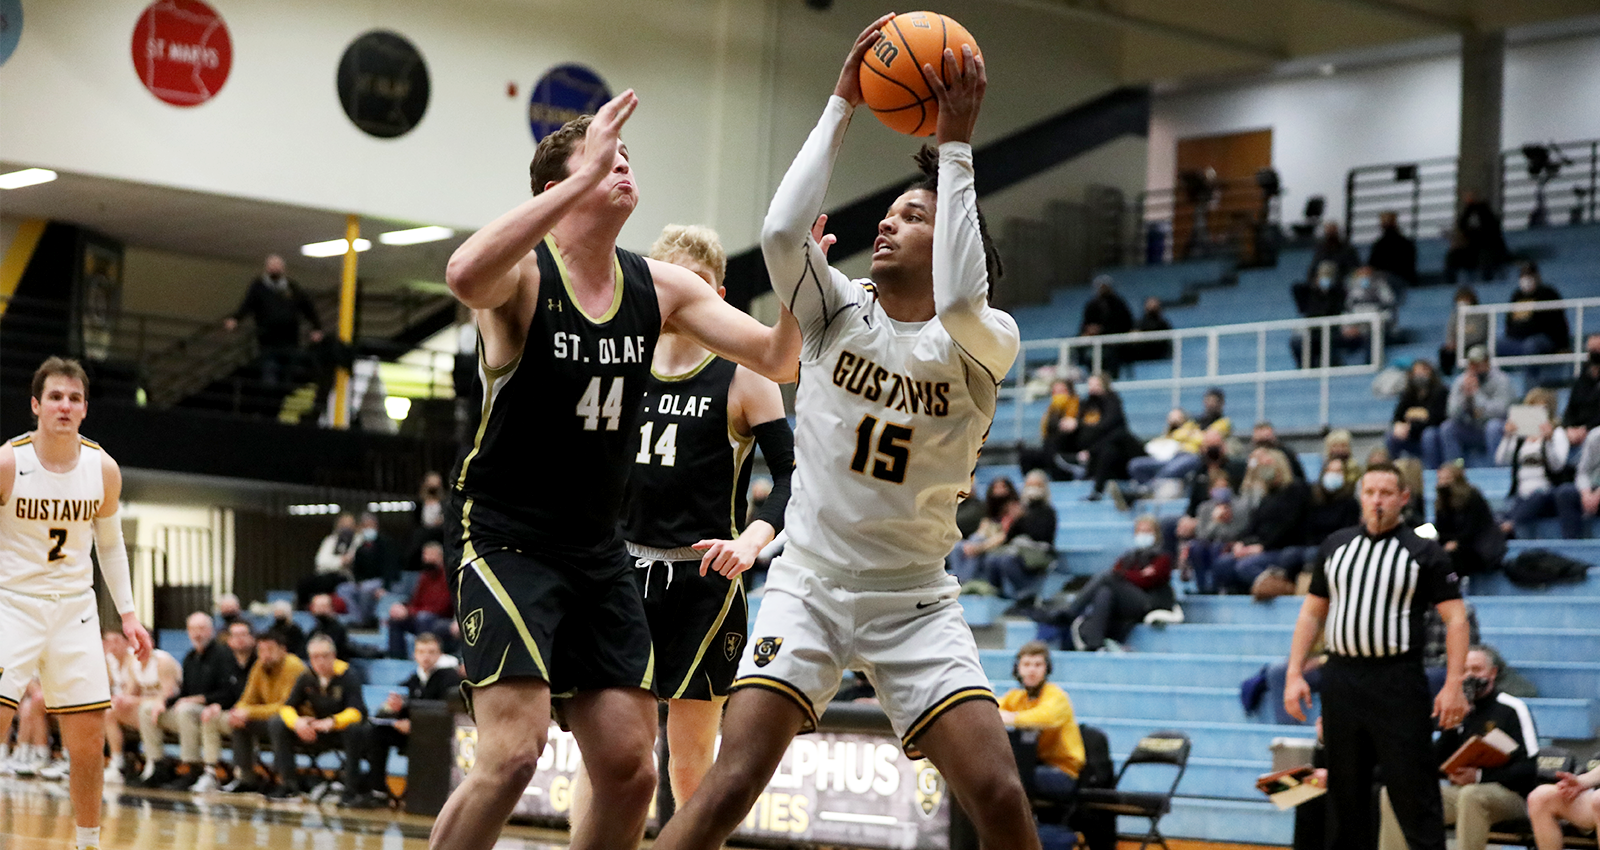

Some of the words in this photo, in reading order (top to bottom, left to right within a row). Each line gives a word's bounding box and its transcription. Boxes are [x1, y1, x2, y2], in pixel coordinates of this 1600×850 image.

[554, 331, 590, 363] ST.
[599, 335, 645, 364] OLAF
[575, 376, 625, 431] 44
[657, 394, 712, 417] OLAF
[635, 421, 678, 467] 14
[850, 413, 915, 485] 15
[48, 528, 67, 562] 2
[769, 738, 900, 796] LPHUS
[744, 793, 809, 833] TIES
